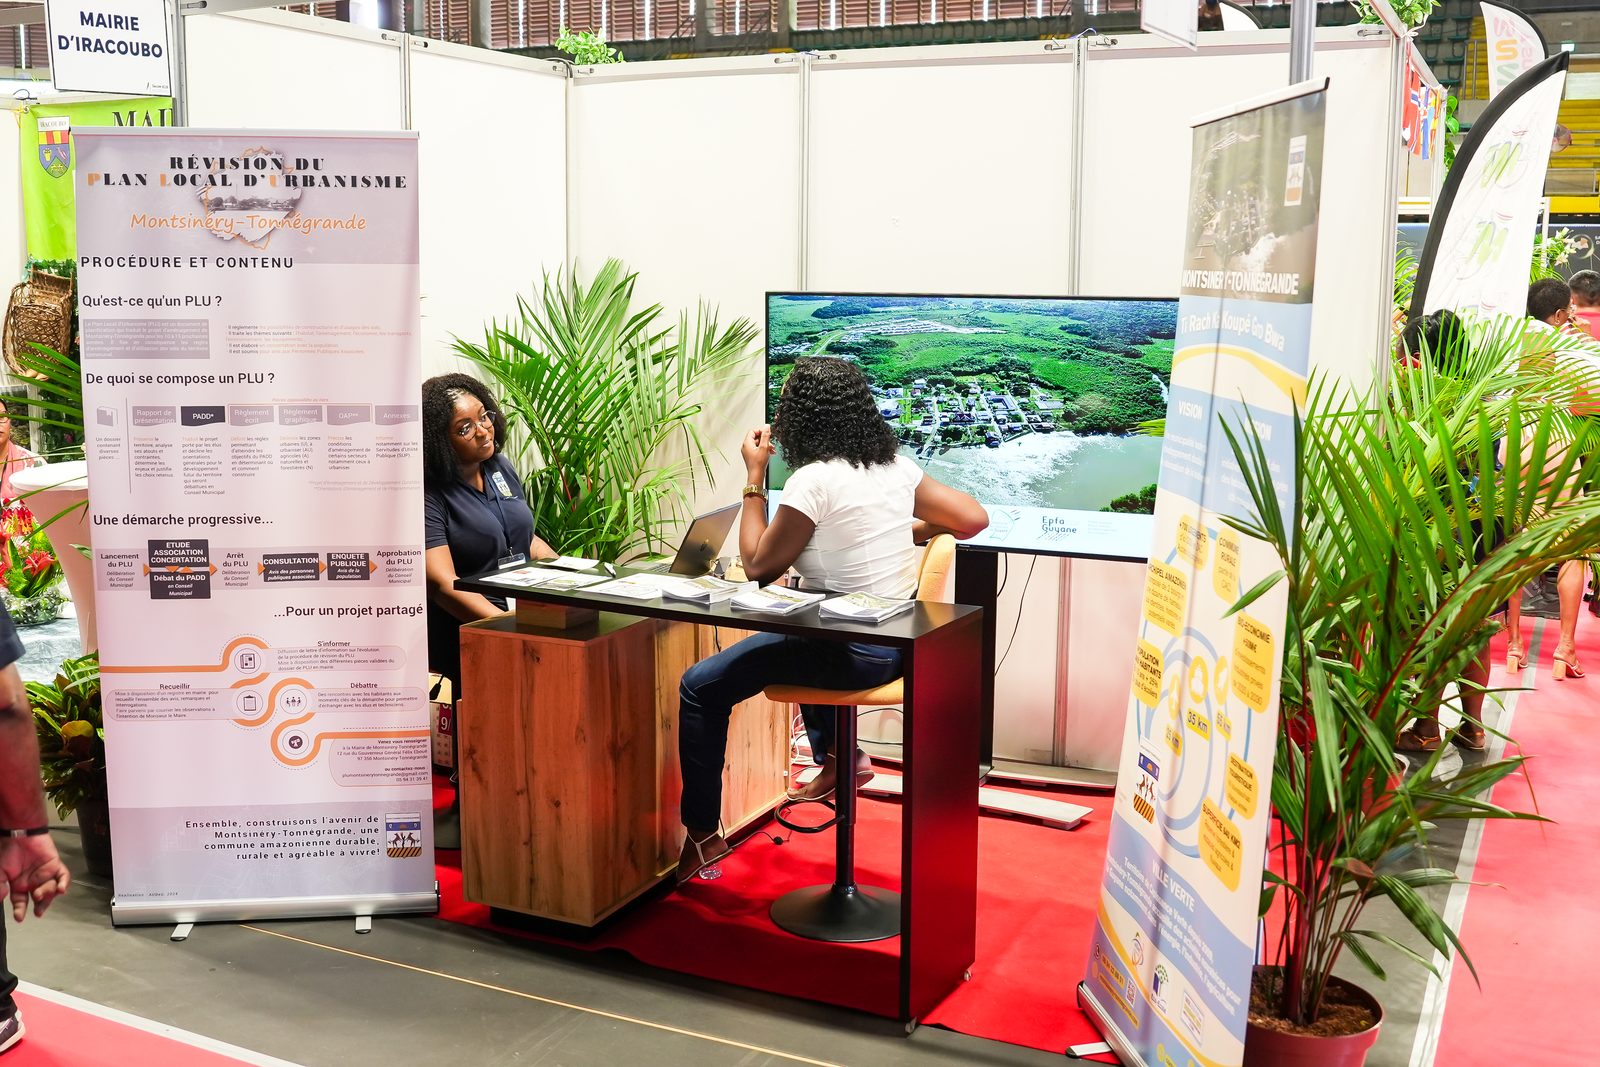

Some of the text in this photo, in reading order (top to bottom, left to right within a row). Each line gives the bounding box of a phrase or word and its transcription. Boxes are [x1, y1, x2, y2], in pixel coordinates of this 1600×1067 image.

[80, 11, 140, 31] MAIRIE
[58, 34, 162, 58] D'IRACOUBO
[112, 108, 172, 127] MAI
[170, 152, 324, 172] RÉVISION DU
[88, 173, 408, 189] PLAN LOCAL D'URBANISME
[130, 212, 366, 234] Montsinéry-Tonnégrande
[81, 254, 294, 269] PROCÉDURE ET CONTENU
[82, 295, 222, 309] Qu'est-ce qu'un PLU ?
[1181, 310, 1285, 352] Ti Rach Ka Koupé Gro Bwa
[86, 372, 275, 386] De quoi se compose un PLU ?
[1178, 400, 1202, 419] VISION
[94, 513, 273, 527] Une démarche progressive...
[1042, 516, 1065, 526] Epfa
[1042, 524, 1077, 534] Guyane
[264, 557, 319, 565] CONSULTATION
[377, 550, 422, 558] Approbation
[274, 604, 423, 617] ...Pour un projet partagé
[1188, 711, 1208, 734] 35 km
[185, 815, 379, 830] Ensemble, construisons l'avenir de
[214, 827, 356, 839] Montsinéry-Tonnégrande,
[260, 839, 331, 849] amazonienne
[335, 838, 380, 848] durable,
[237, 848, 381, 861] rurale et agréable à vivre!
[1152, 860, 1196, 912] VILLE VERTE
